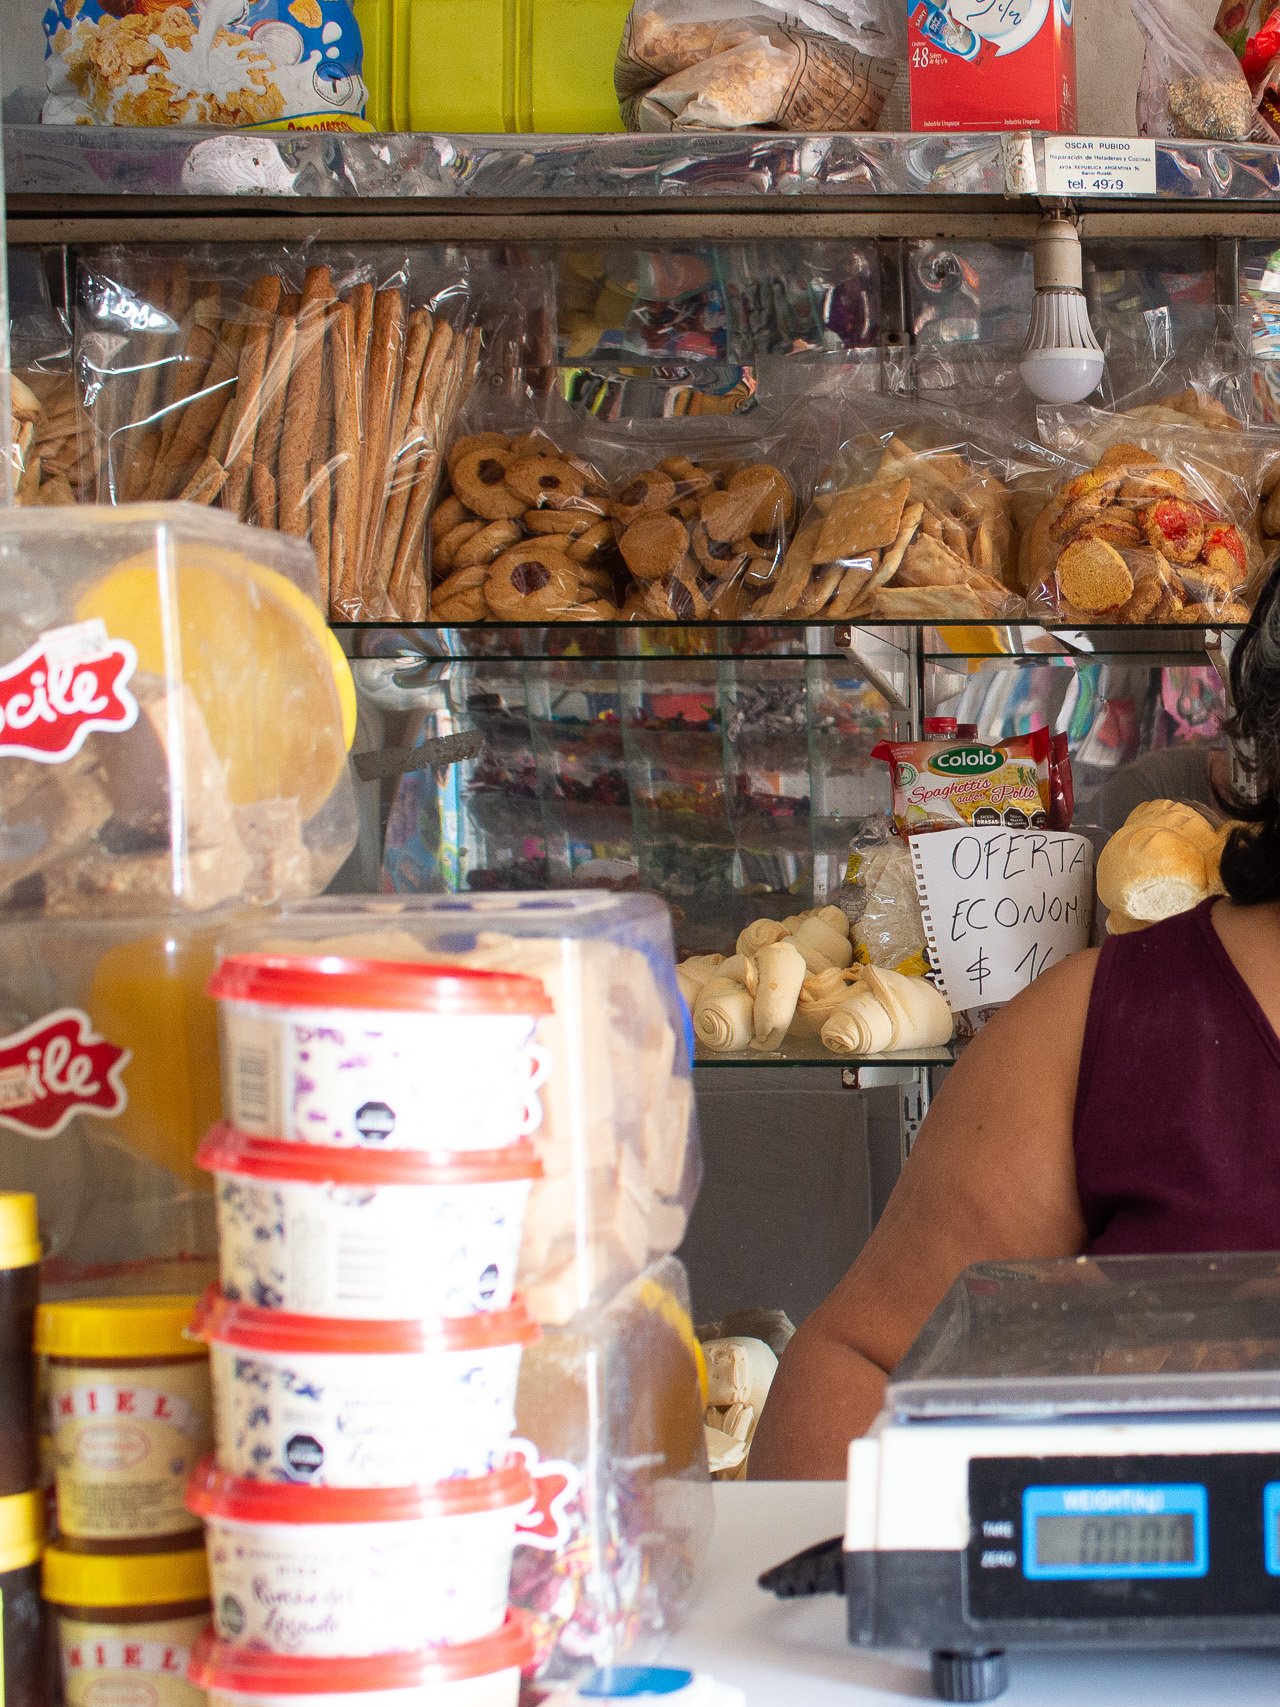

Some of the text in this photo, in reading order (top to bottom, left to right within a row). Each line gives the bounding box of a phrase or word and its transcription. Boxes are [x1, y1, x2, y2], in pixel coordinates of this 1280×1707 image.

[912, 47, 929, 68] 48
[1064, 142, 1094, 150] OSCAR
[1068, 179, 1124, 190] tel. 4979
[0, 662, 110, 735] cile
[907, 778, 992, 804] Spaghettis
[956, 785, 1037, 805] sabor Pollo
[952, 833, 1087, 880] OFERTA
[965, 946, 991, 996] $
